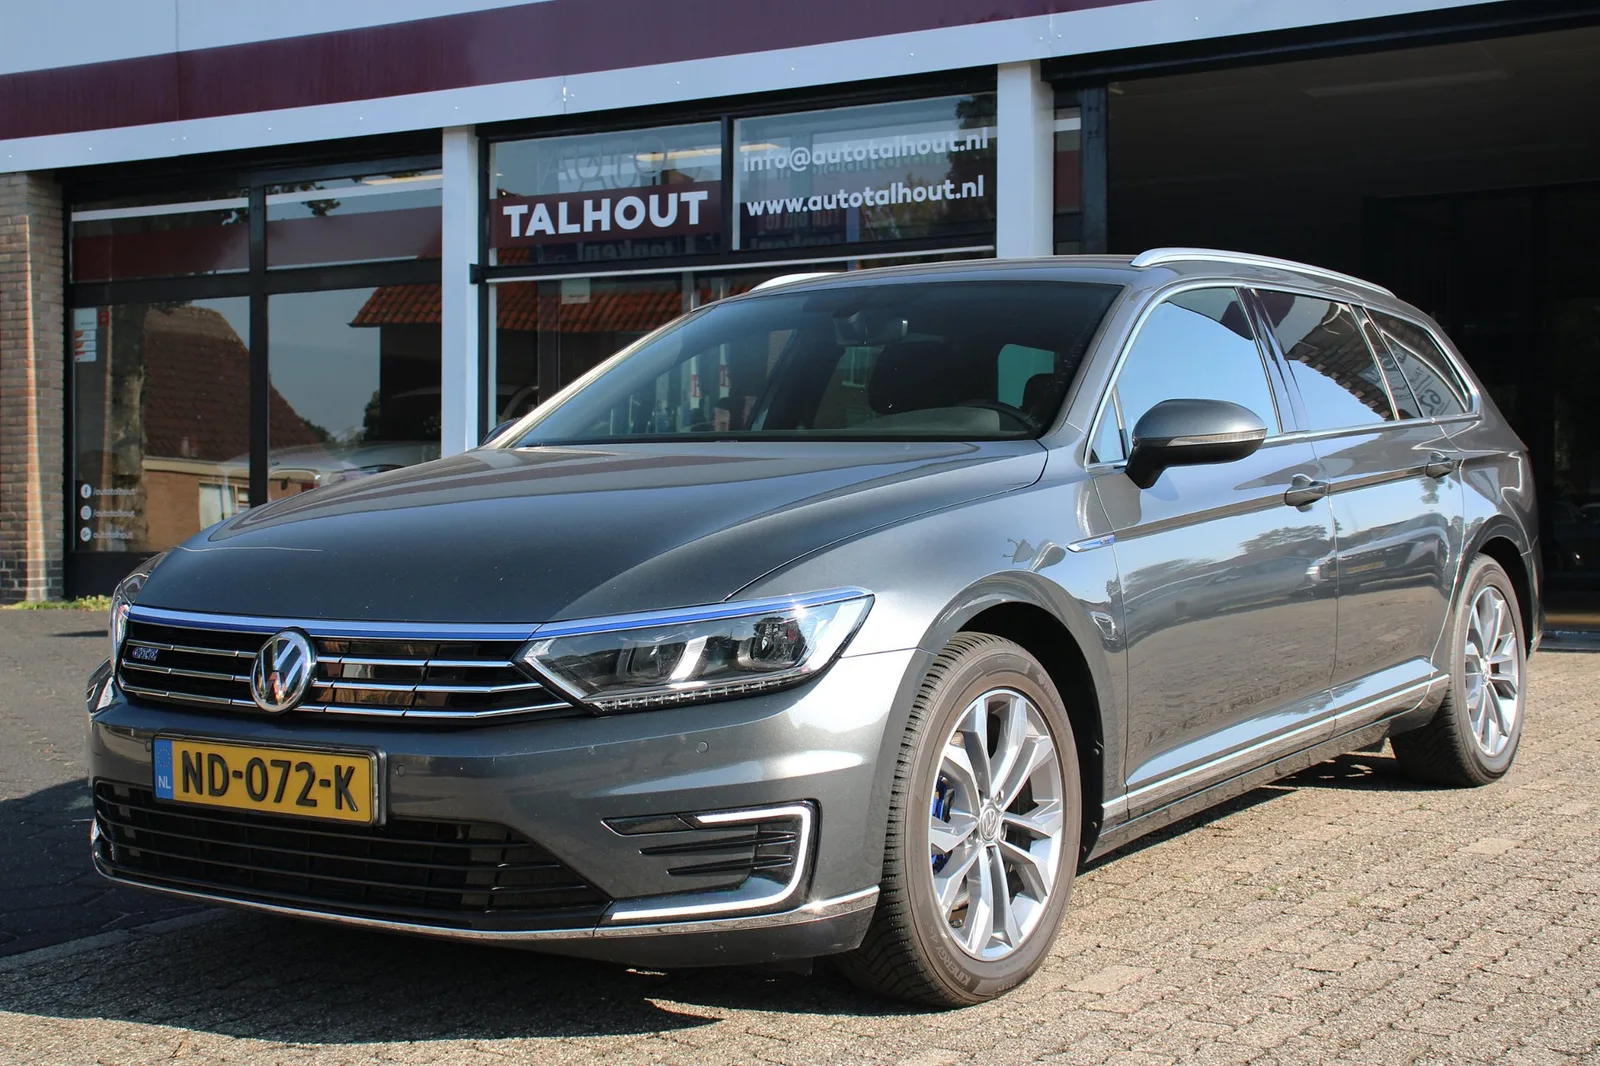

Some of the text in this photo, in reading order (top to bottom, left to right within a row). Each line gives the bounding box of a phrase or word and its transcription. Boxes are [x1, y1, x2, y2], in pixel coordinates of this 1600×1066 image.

[743, 126, 989, 172] info@autotalhout.nl
[502, 190, 708, 238] TALHOUT
[746, 174, 985, 217] www.autotalhout.nl
[157, 775, 172, 790] NL
[181, 750, 359, 813] ND-072-K
